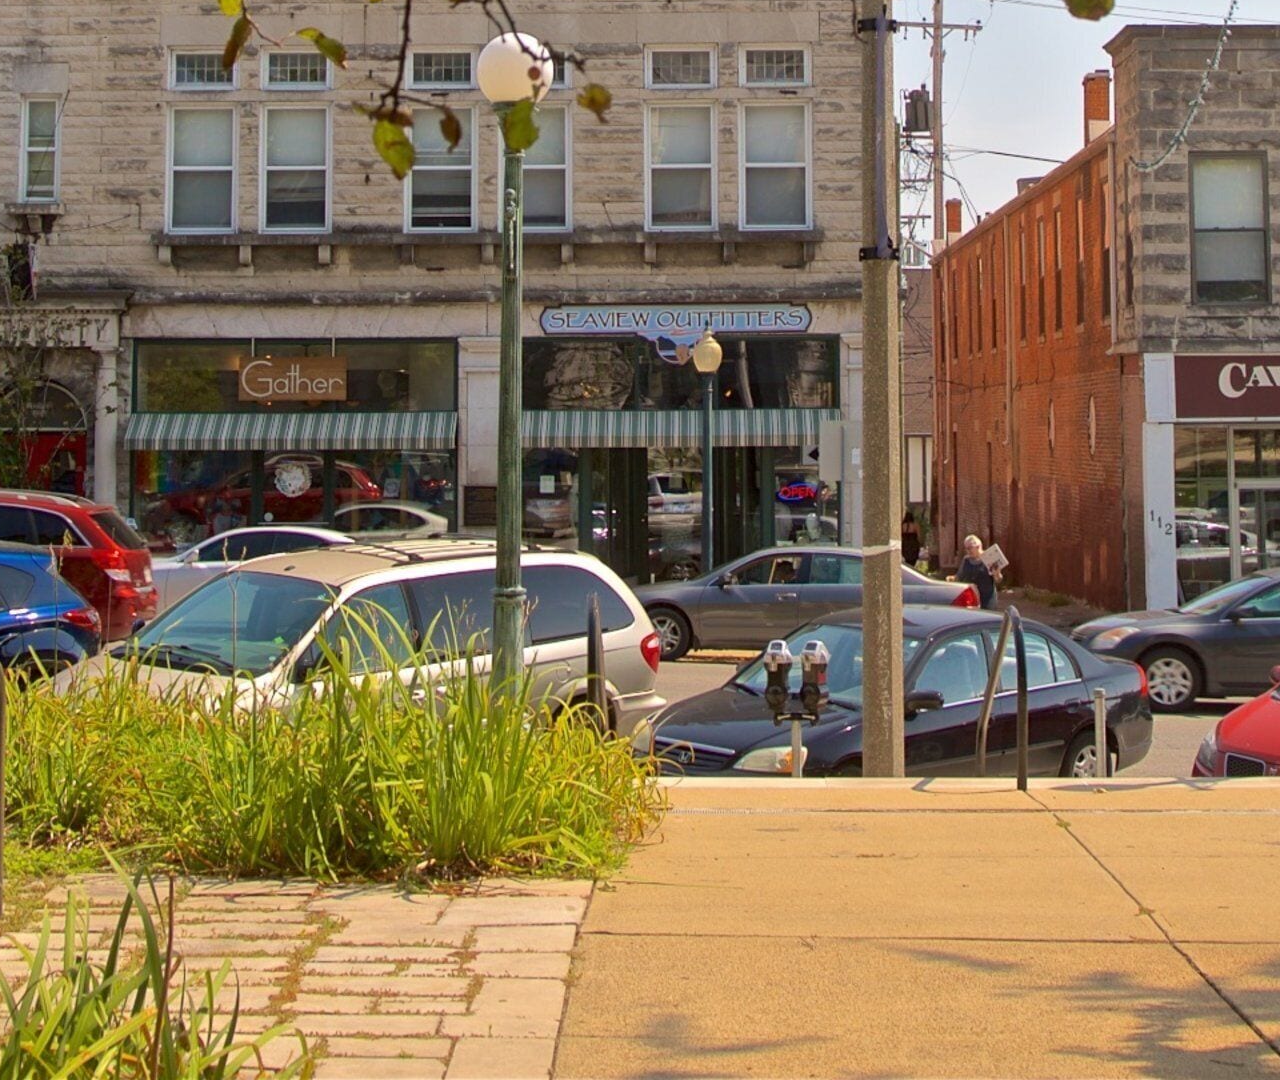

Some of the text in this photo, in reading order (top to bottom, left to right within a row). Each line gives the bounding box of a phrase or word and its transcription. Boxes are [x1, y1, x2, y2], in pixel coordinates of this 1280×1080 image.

[549, 309, 804, 329] SEAVIEW OUTFITTERS
[241, 360, 343, 398] Gather
[780, 486, 816, 499] OPEN
[1150, 509, 1173, 535] 112
